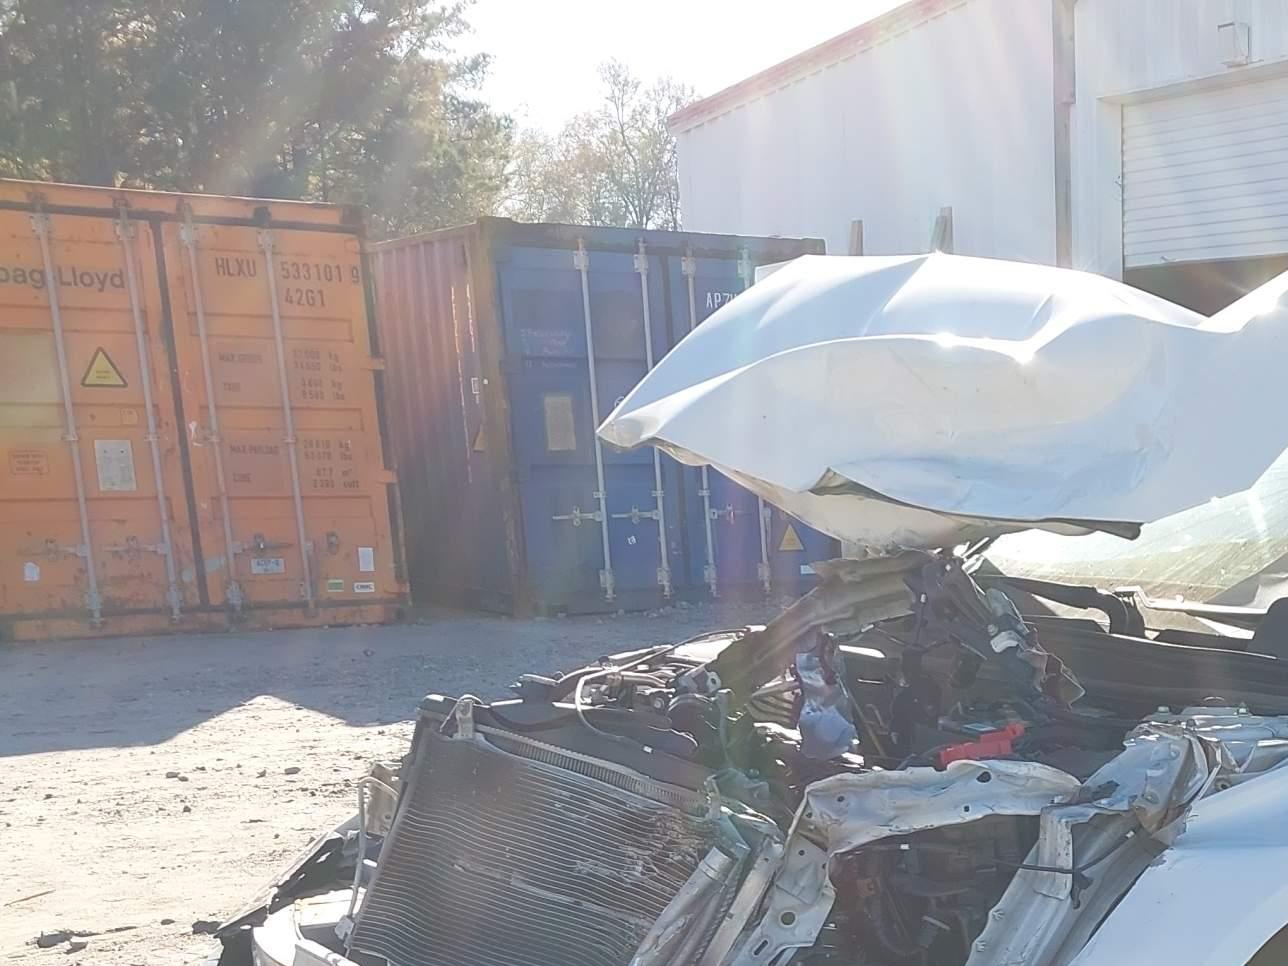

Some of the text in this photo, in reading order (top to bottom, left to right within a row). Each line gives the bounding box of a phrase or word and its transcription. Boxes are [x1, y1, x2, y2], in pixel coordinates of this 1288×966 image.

[216, 257, 256, 277] HLXU
[280, 261, 342, 282] 533101
[285, 288, 325, 307] 42G1
